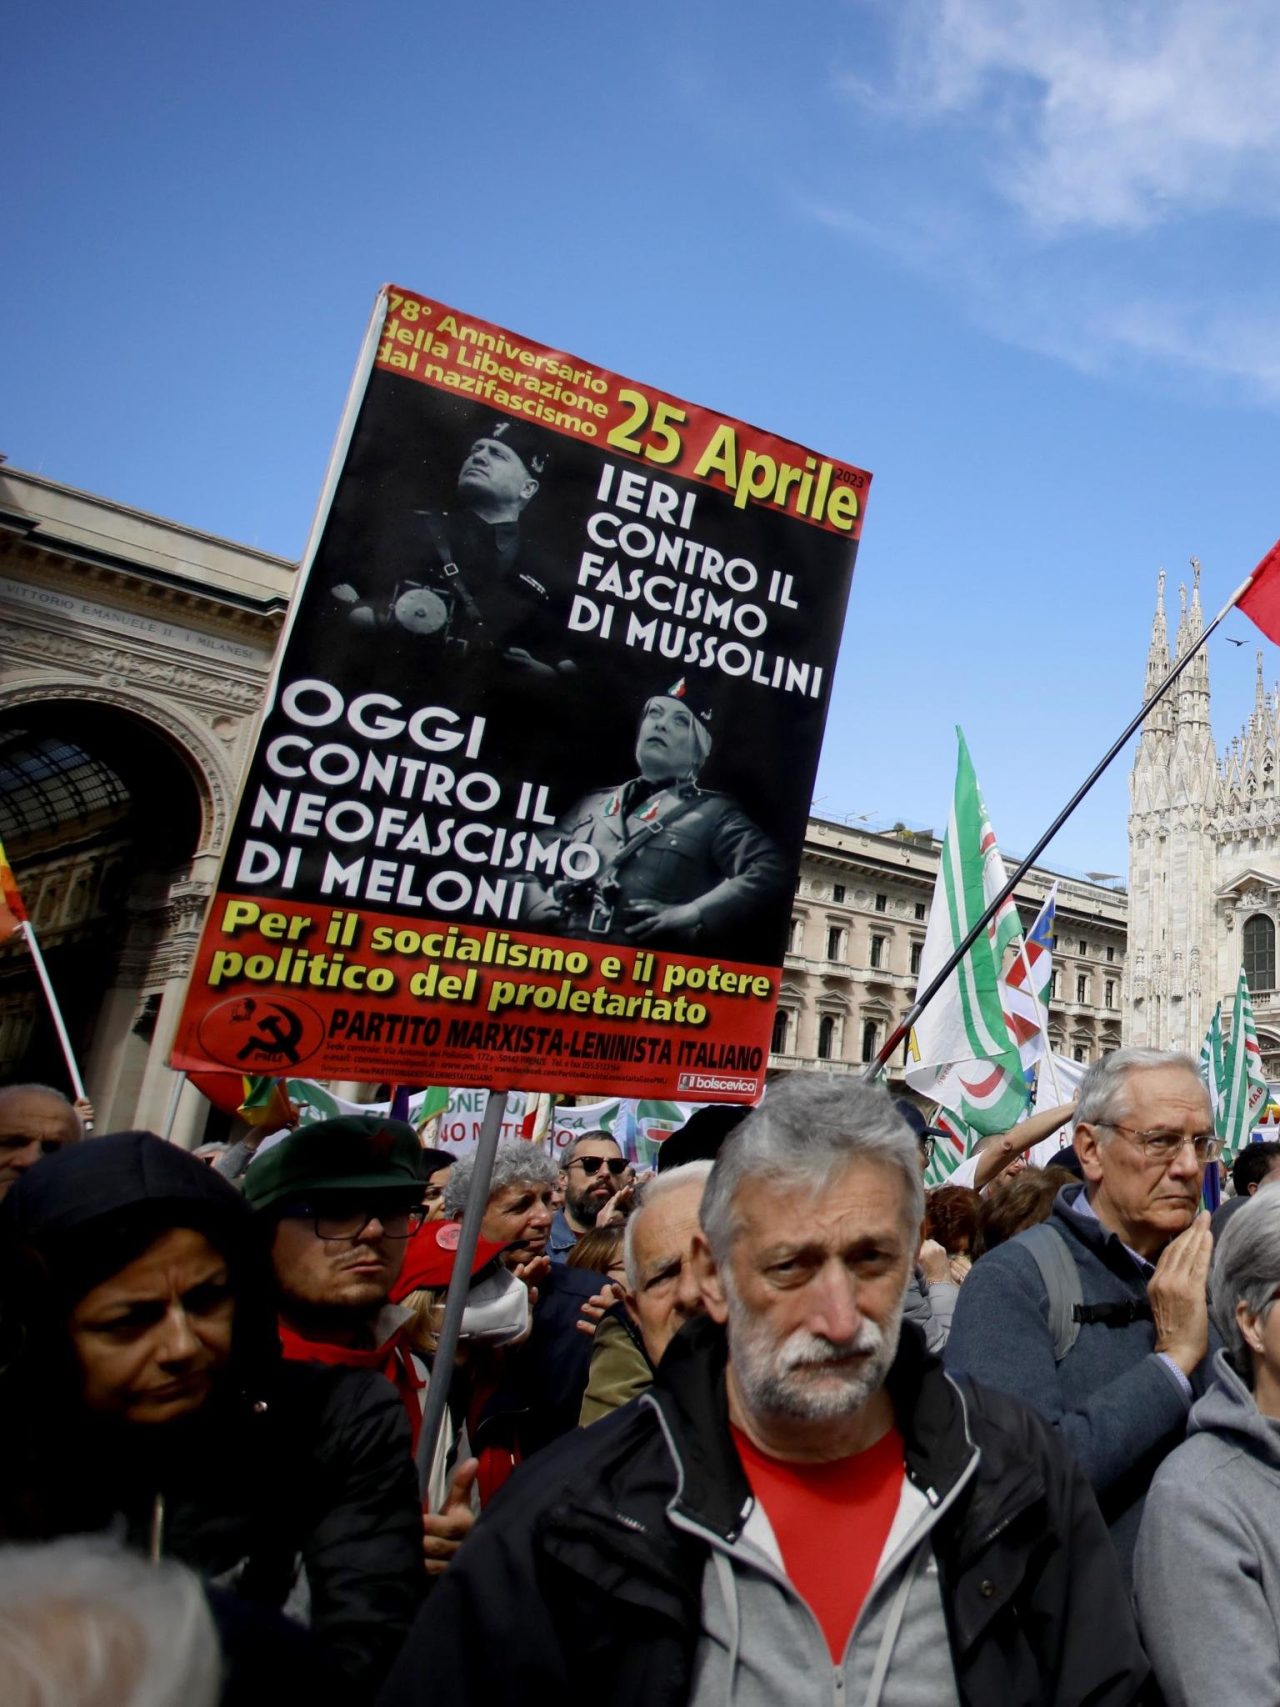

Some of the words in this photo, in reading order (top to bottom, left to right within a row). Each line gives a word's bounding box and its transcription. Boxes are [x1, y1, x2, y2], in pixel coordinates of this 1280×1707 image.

[378, 342, 418, 372] dal
[424, 363, 597, 437] nazifascismo
[384, 318, 449, 360] della
[456, 345, 608, 419] Liberazione
[436, 315, 608, 395] Anniversario
[597, 463, 696, 530] IERI
[606, 389, 686, 464] 25
[693, 424, 857, 531] Aprile
[836, 467, 865, 489] 2023
[577, 551, 767, 638] FASCISMO
[587, 512, 758, 593] CONTRO
[768, 570, 798, 610] IL
[6, 583, 74, 610] VITTORIO
[81, 605, 156, 633] EMANUELE
[196, 637, 253, 659] MILANESI
[567, 594, 615, 639] DI
[626, 608, 823, 698] MUSSOLINI
[281, 678, 487, 759] OGGI
[265, 735, 501, 812] CONTRO
[516, 782, 556, 825] IL
[250, 784, 600, 881] NEOFASCISMO
[236, 840, 304, 889] DI
[320, 853, 525, 921] MELONI
[208, 947, 395, 993] politico
[409, 966, 478, 1001] del
[487, 977, 708, 1026] proletariato
[220, 900, 317, 941] Per
[325, 910, 357, 946] il
[370, 921, 589, 974] socialismo
[600, 948, 620, 980] e
[632, 952, 655, 983] il
[661, 963, 771, 998] potere
[328, 1009, 441, 1046] PARTITO
[445, 1020, 672, 1065] MARXISTA-LENINISTA
[677, 1041, 763, 1072] ITALIANO
[697, 1077, 755, 1092] bolscevico
